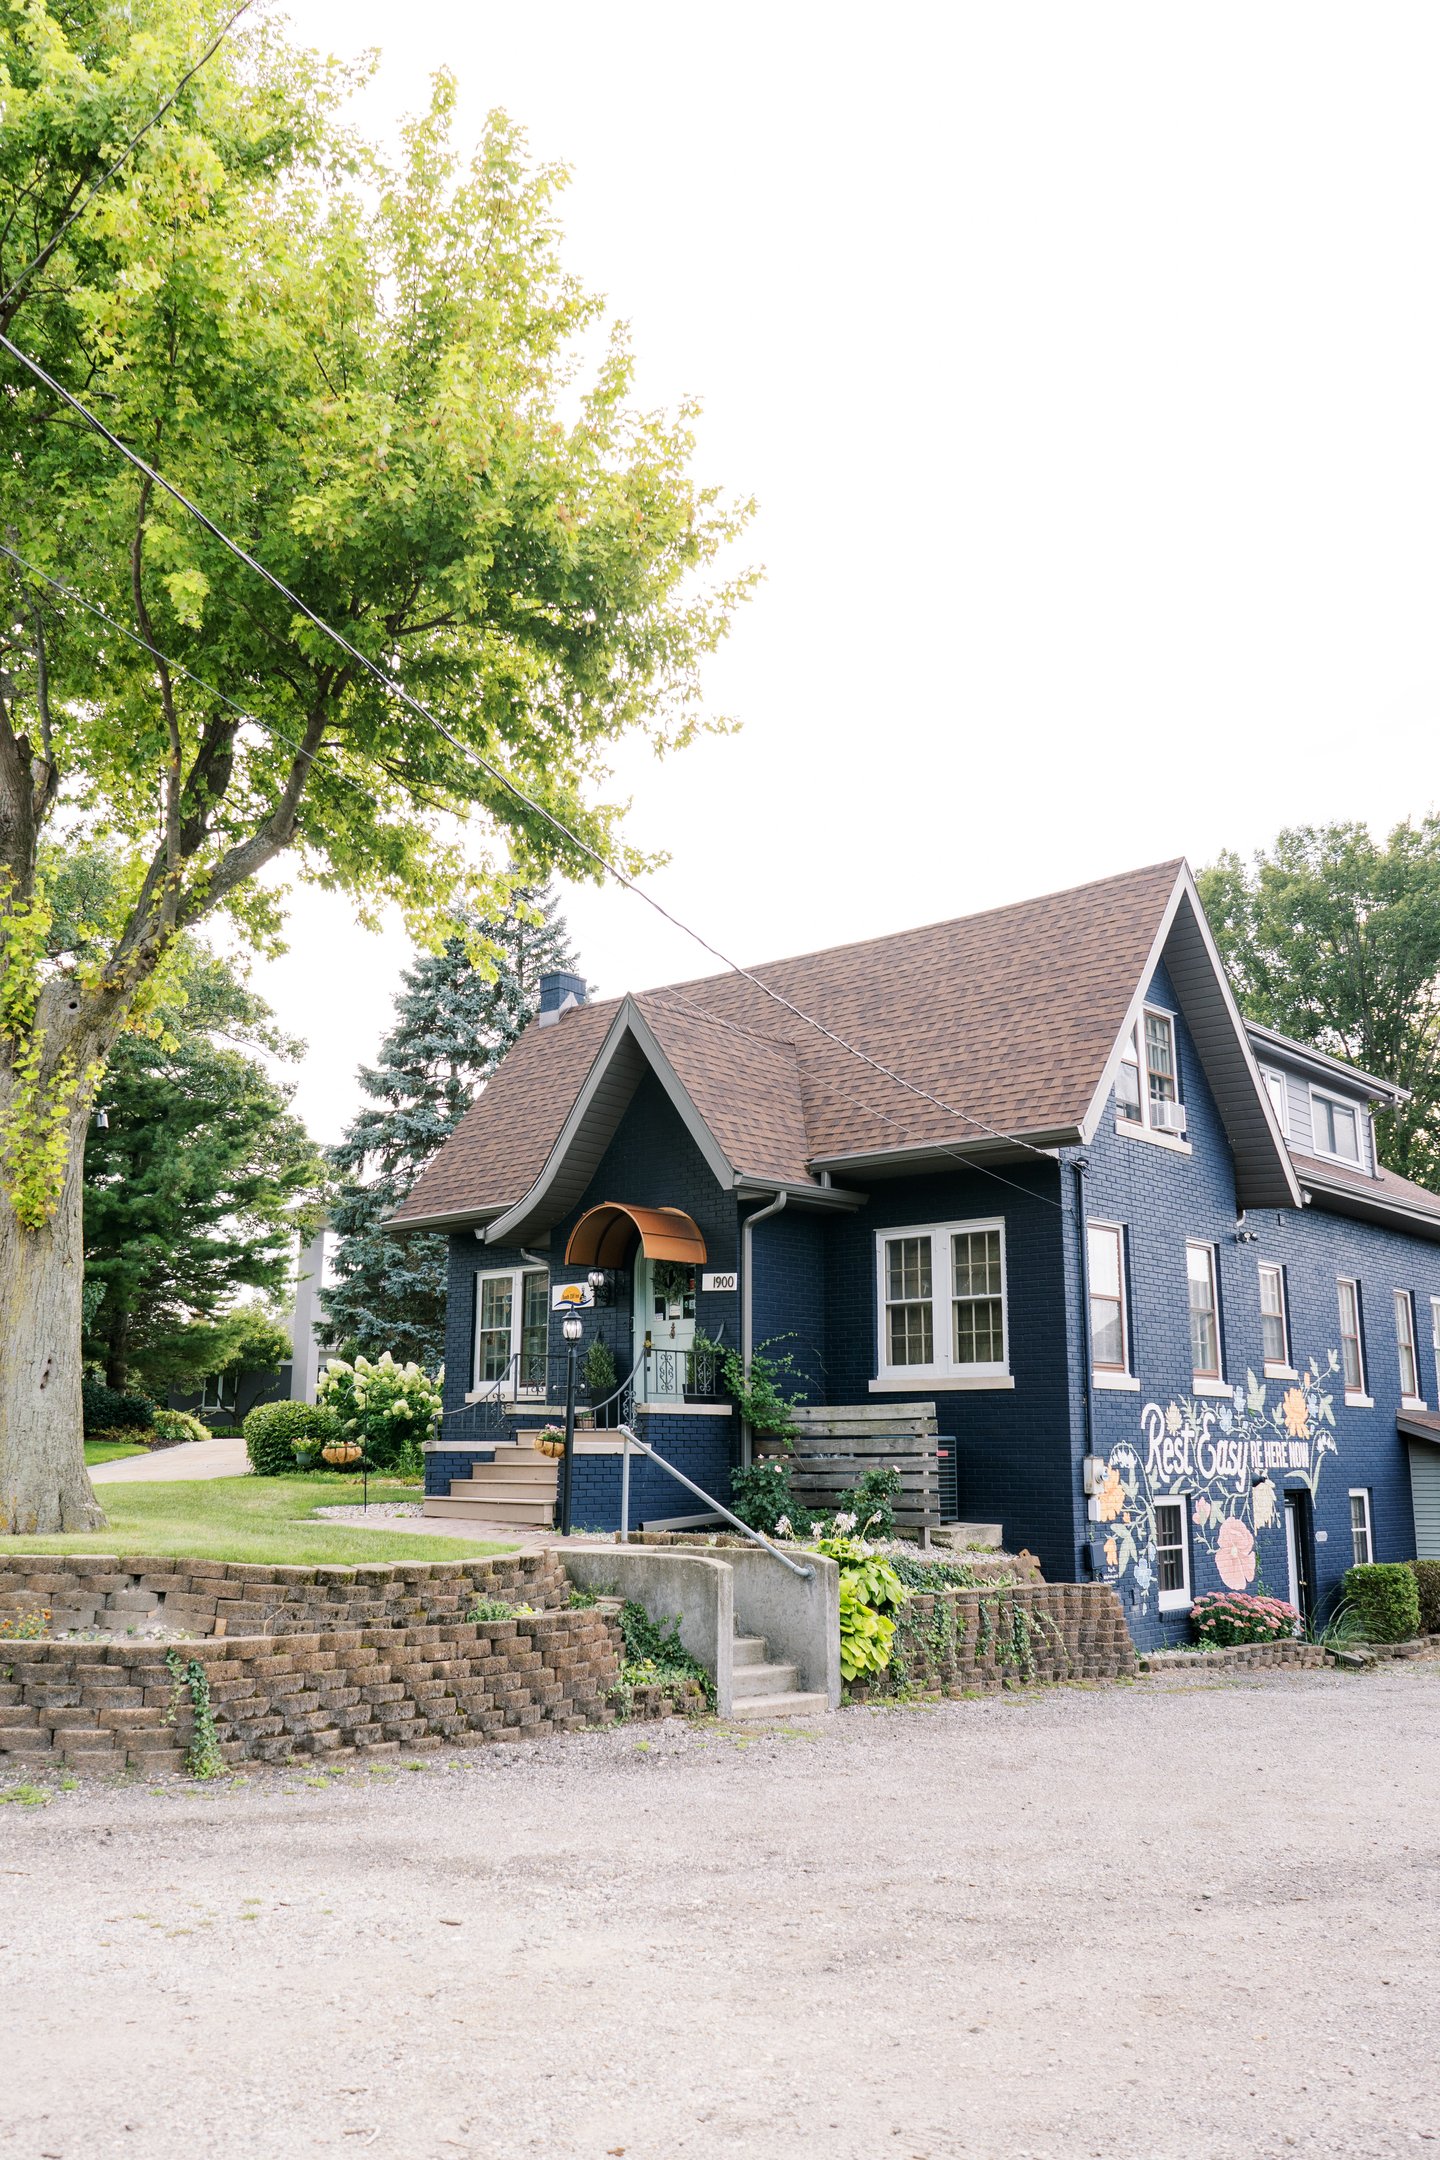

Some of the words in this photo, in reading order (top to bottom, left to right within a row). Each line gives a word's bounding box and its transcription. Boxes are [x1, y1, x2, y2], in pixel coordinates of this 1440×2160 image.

[713, 1275, 734, 1289] 1900
[1141, 1402, 1195, 1484] Rest
[1197, 1411, 1249, 1493] Easy
[1264, 1441, 1289, 1468] HERE
[1289, 1441, 1310, 1469] NOW
